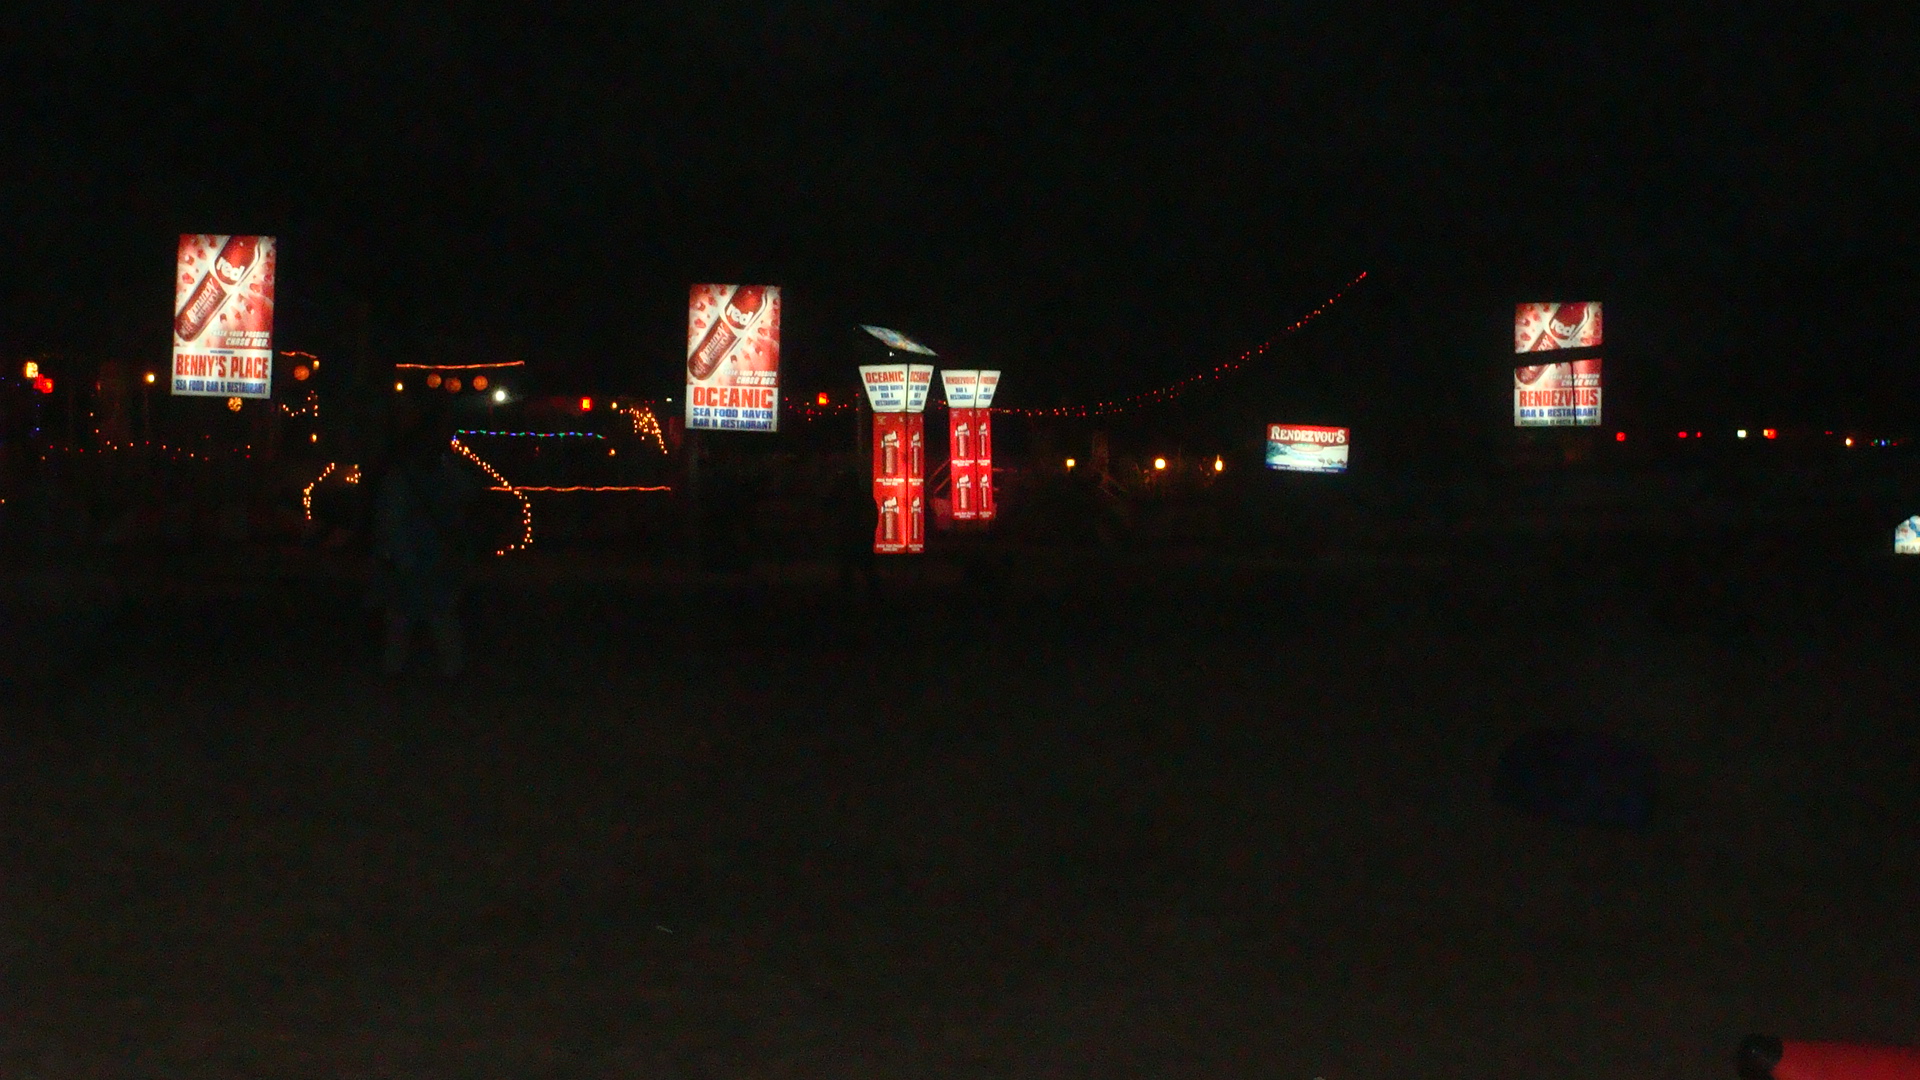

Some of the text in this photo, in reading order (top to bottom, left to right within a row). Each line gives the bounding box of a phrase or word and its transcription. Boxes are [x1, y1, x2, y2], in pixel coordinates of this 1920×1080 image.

[217, 256, 245, 281] red
[726, 303, 754, 326] red
[175, 354, 269, 379] BENNY'S PLACE
[865, 371, 905, 383] OCEANIC
[175, 379, 187, 391] SEA
[188, 380, 205, 391] FOOD
[206, 381, 219, 392] BAR
[226, 381, 267, 394] RESTAURANT
[693, 386, 774, 409] OCEANIC
[1519, 389, 1599, 407] RENDEZVOUS
[692, 407, 773, 419] SEA FOOD HAVEN
[1520, 408, 1537, 418] BAR
[692, 418, 710, 427] BAR
[720, 419, 773, 429] RESTAURANT
